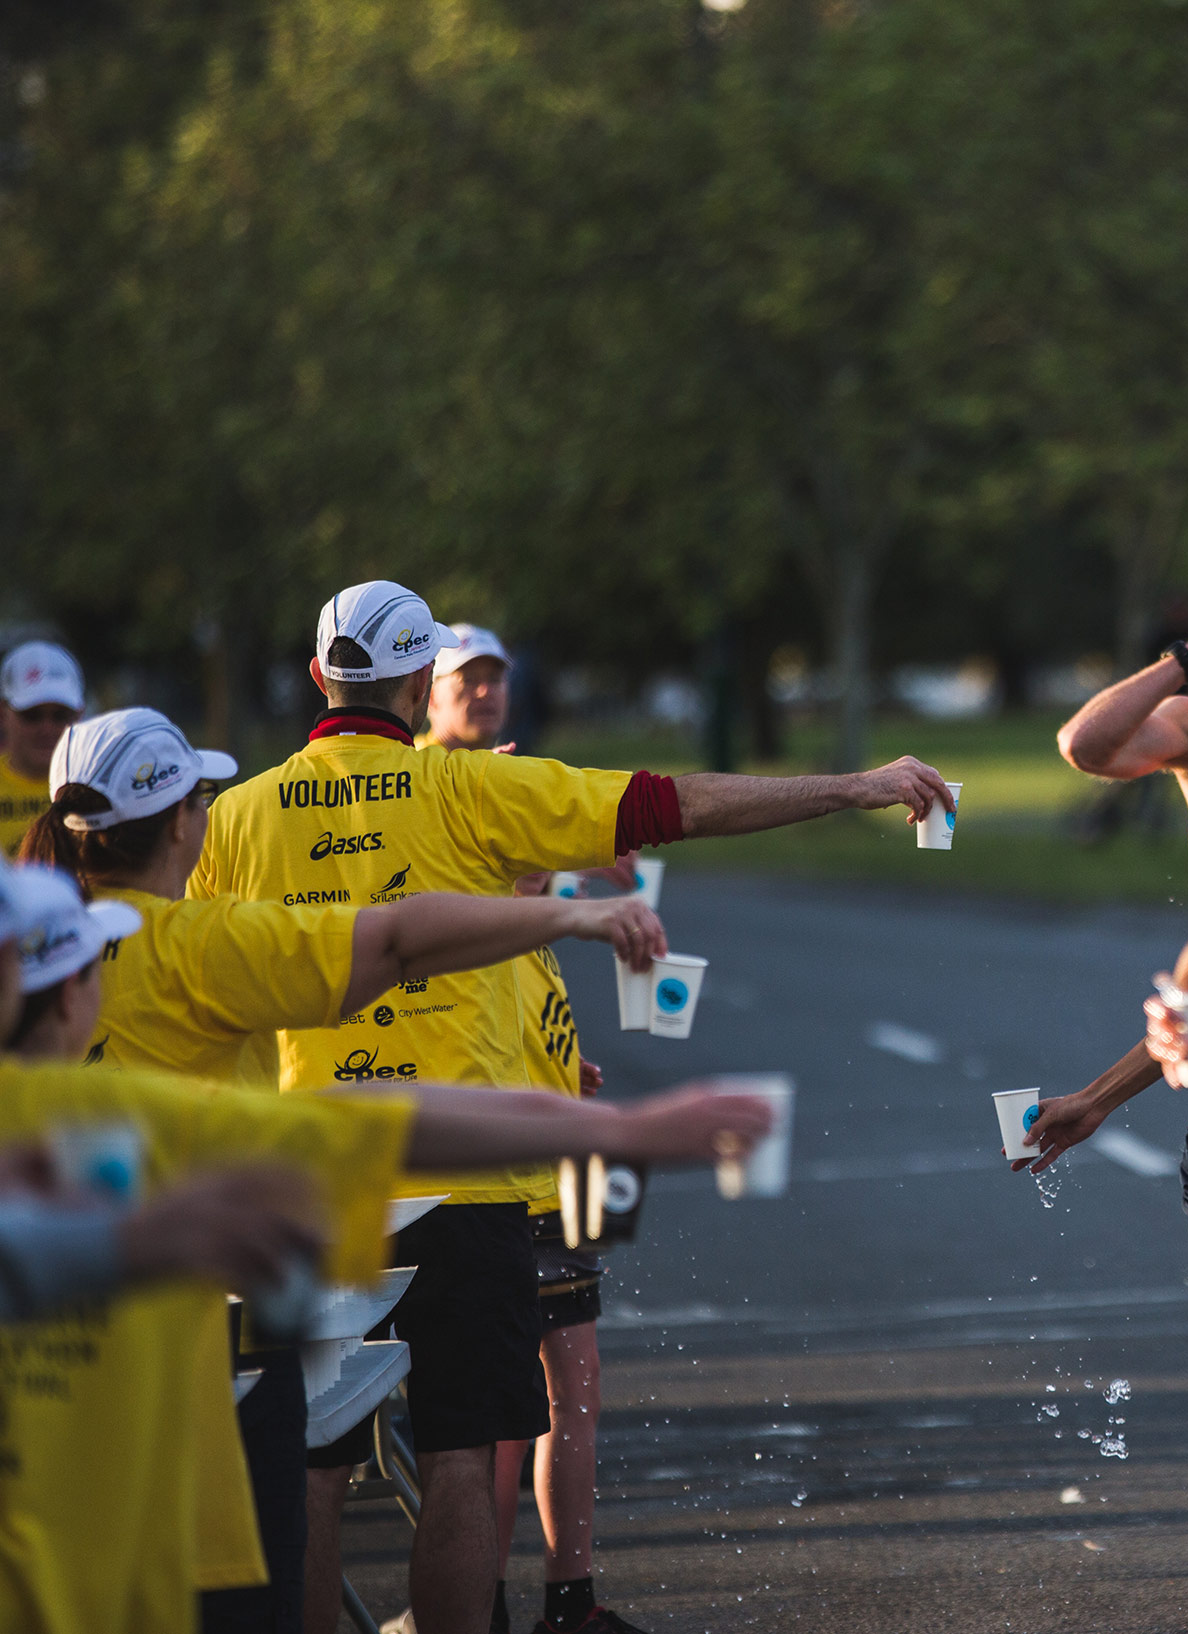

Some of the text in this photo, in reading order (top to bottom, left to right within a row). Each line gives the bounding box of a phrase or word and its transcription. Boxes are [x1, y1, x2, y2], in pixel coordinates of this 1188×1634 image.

[392, 633, 430, 653] cpec
[131, 764, 180, 791] cpec
[278, 771, 412, 808] VOLUNTEER
[284, 889, 351, 906] GARMIN
[405, 983, 427, 994] me
[398, 1009, 413, 1018] City
[413, 1007, 431, 1015] West
[334, 1063, 417, 1084] cpec
